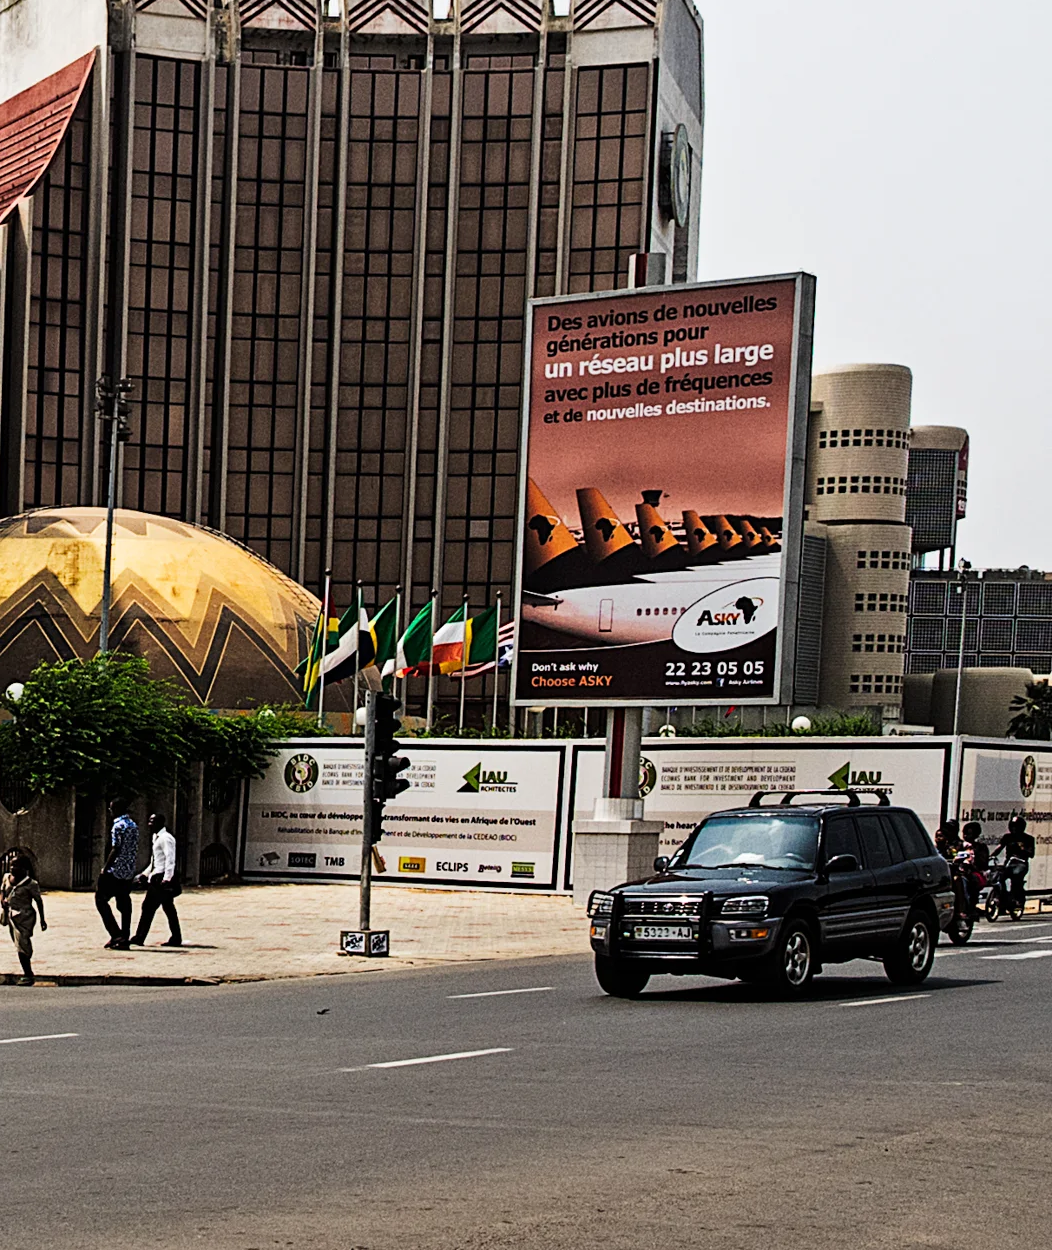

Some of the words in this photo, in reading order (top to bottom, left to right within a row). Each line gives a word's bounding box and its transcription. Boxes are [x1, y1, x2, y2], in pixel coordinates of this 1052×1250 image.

[548, 315, 582, 331] Des
[587, 309, 648, 328] avions
[653, 304, 678, 322] de
[683, 296, 777, 318] nouvelles
[546, 331, 658, 357] générations
[663, 326, 709, 347] pour
[545, 361, 572, 379] un
[579, 353, 654, 376] réseau
[660, 347, 708, 373] plus
[714, 343, 774, 367] large
[544, 387, 588, 403] avec
[592, 382, 631, 403] plus
[636, 378, 660, 396] de
[665, 371, 773, 394] fréquences
[543, 410, 560, 424] et
[563, 408, 583, 423] de
[587, 403, 663, 421] nouvelles
[666, 395, 771, 415] destinations.
[531, 662, 558, 672] Don't
[559, 662, 576, 671] ask
[578, 662, 599, 672] why
[665, 662, 686, 676] 22
[691, 661, 712, 676] 23
[717, 661, 738, 675] 05
[743, 661, 764, 675] 05
[531, 676, 576, 687] Choose
[579, 675, 613, 686] ASKY
[290, 754, 316, 766] BIDC
[482, 770, 508, 783] IAU
[289, 780, 314, 792] EBID
[261, 810, 269, 819] La
[317, 811, 327, 819] du
[327, 812, 363, 822] développe
[384, 814, 430, 823] transformant
[431, 815, 444, 823] des
[445, 816, 459, 824] vies
[471, 816, 498, 826] Afrique
[499, 817, 509, 825] de
[510, 817, 536, 826] l'Ouest
[961, 808, 969, 822] La
[676, 821, 697, 830] heart
[329, 828, 350, 836] Banque
[473, 833, 497, 841] CEDEAO
[664, 838, 670, 846] la
[671, 838, 684, 846] Ban
[324, 856, 345, 866] TMB
[436, 861, 469, 872] ECLIPS
